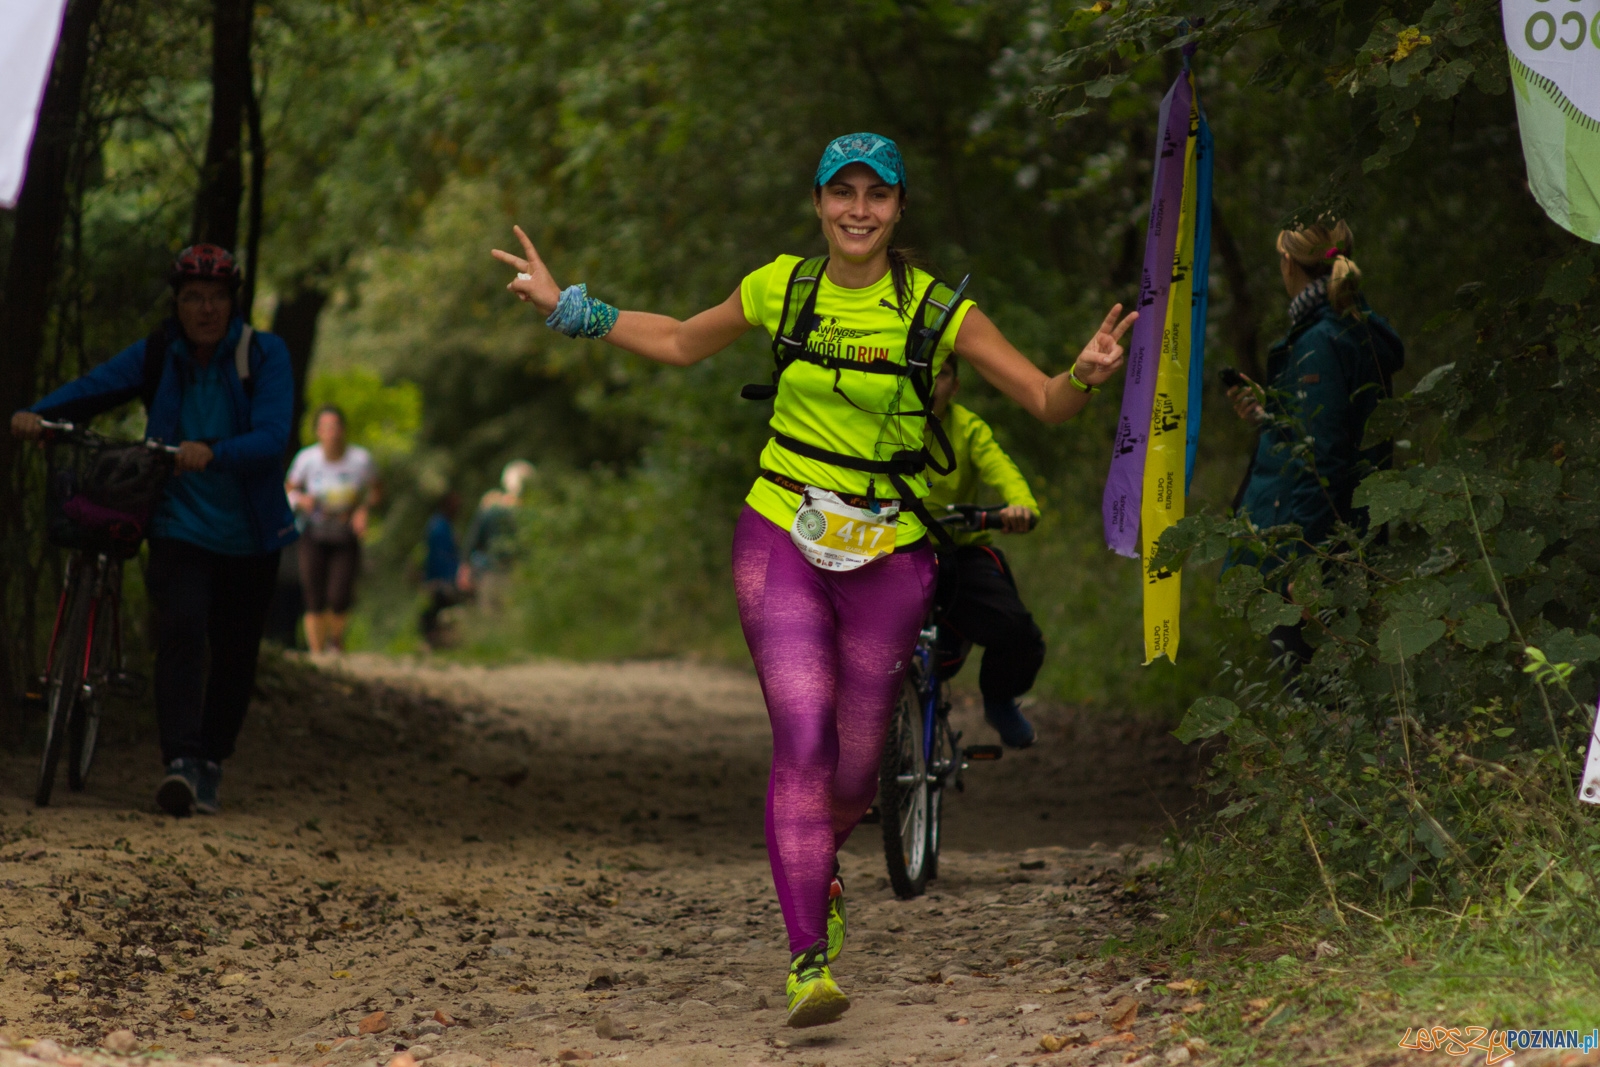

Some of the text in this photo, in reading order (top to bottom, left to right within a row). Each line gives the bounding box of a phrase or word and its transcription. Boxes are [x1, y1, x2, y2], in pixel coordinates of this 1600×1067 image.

[819, 325, 857, 338] WINGS
[1163, 329, 1171, 354] DALPO
[1171, 322, 1180, 361] EUROTAPE
[1135, 346, 1145, 384] EUROTAPE
[1157, 477, 1165, 503] DALPO
[1165, 471, 1174, 510] EUROTAPE
[836, 520, 885, 549] 417
